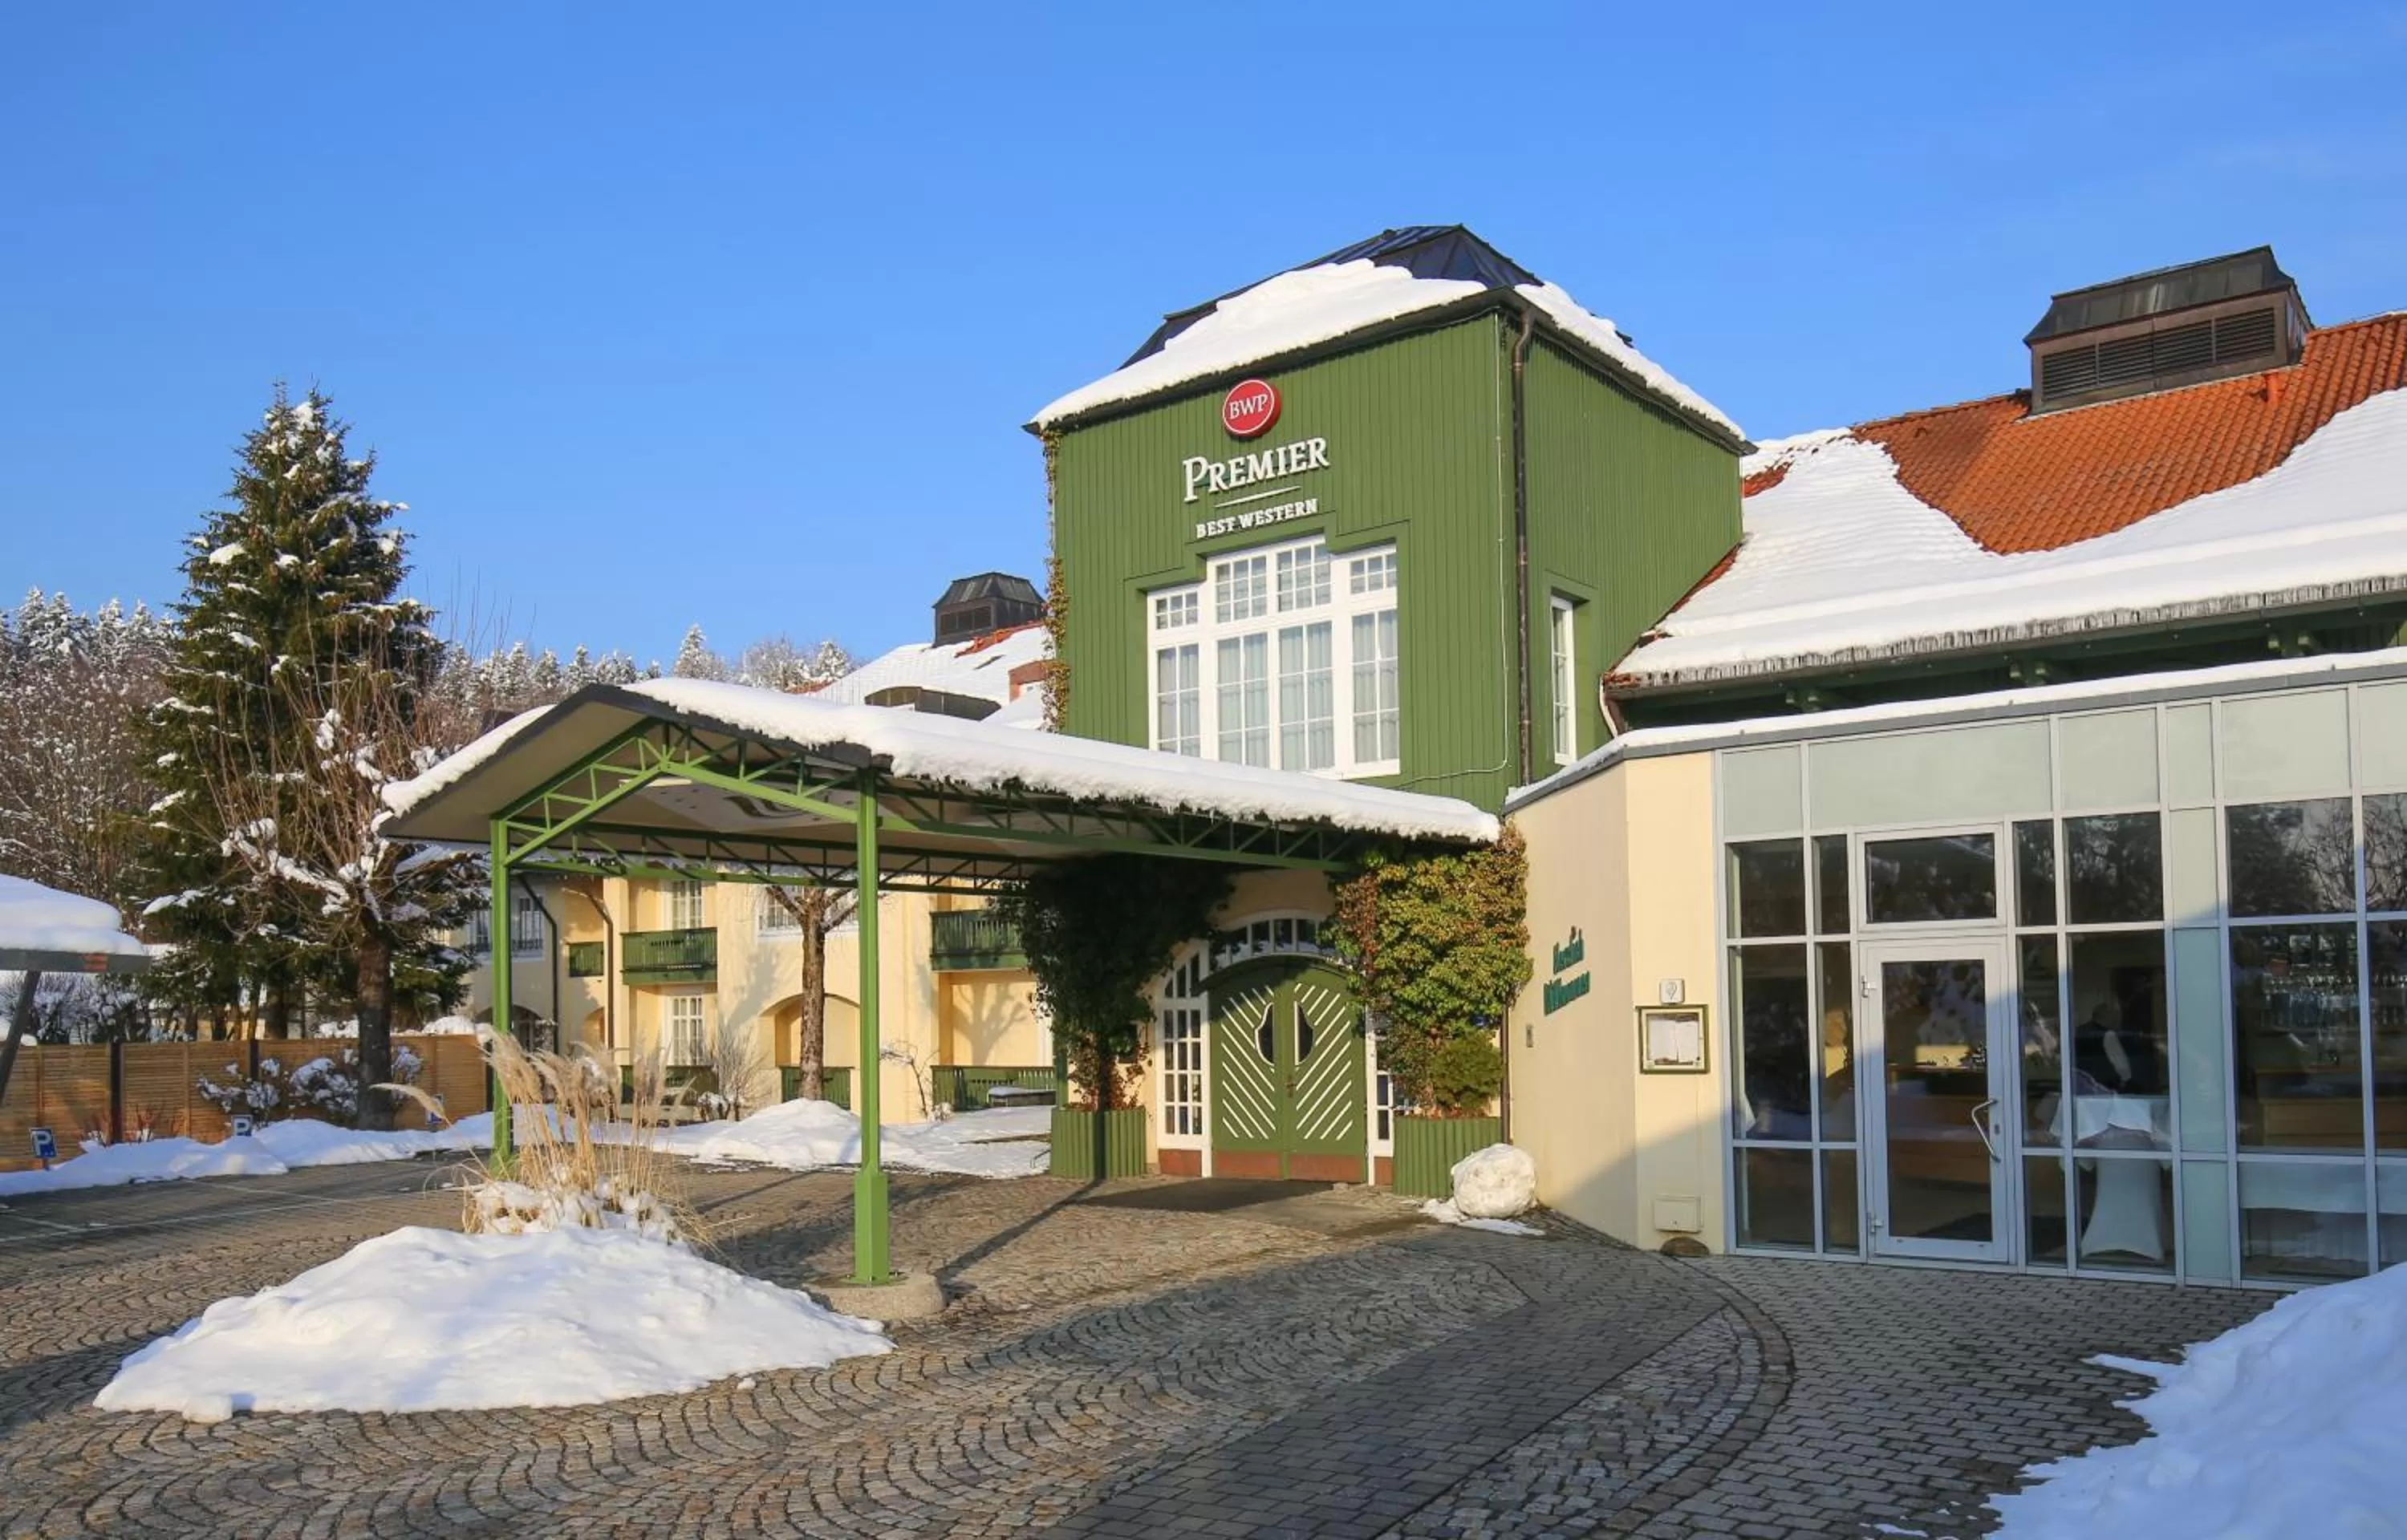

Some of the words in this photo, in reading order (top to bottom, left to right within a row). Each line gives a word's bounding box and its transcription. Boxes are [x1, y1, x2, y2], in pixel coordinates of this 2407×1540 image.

[1229, 393, 1268, 419] BWP
[1183, 437, 1330, 502] PREMIER
[1195, 516, 1236, 539] BEST
[1238, 498, 1319, 529] WESTERN
[32, 1130, 52, 1156] P
